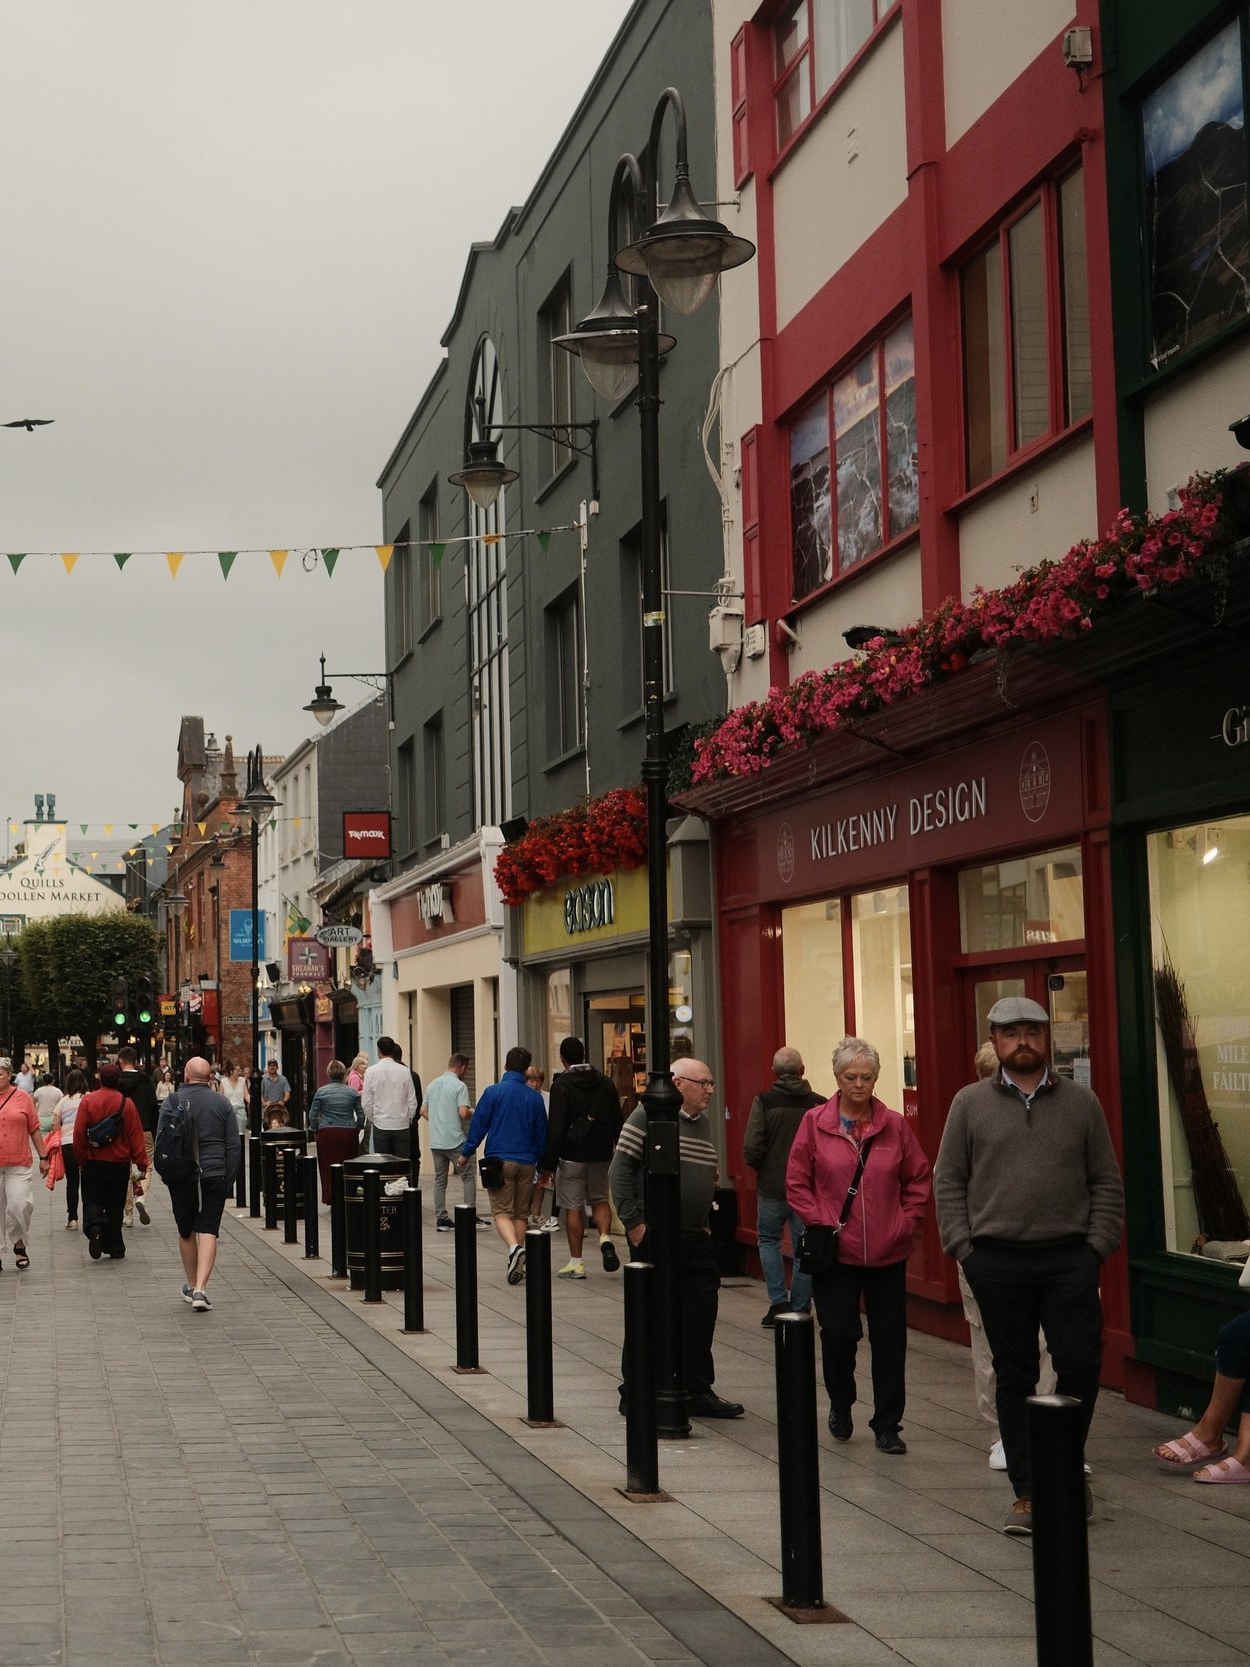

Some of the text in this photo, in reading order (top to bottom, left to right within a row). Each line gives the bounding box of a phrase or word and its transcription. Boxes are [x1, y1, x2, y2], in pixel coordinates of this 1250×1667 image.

[811, 776, 988, 861] KILKENNY DESIGN
[20, 878, 65, 889] QUILLS
[51, 892, 101, 902] MARKET
[330, 927, 350, 936] ART
